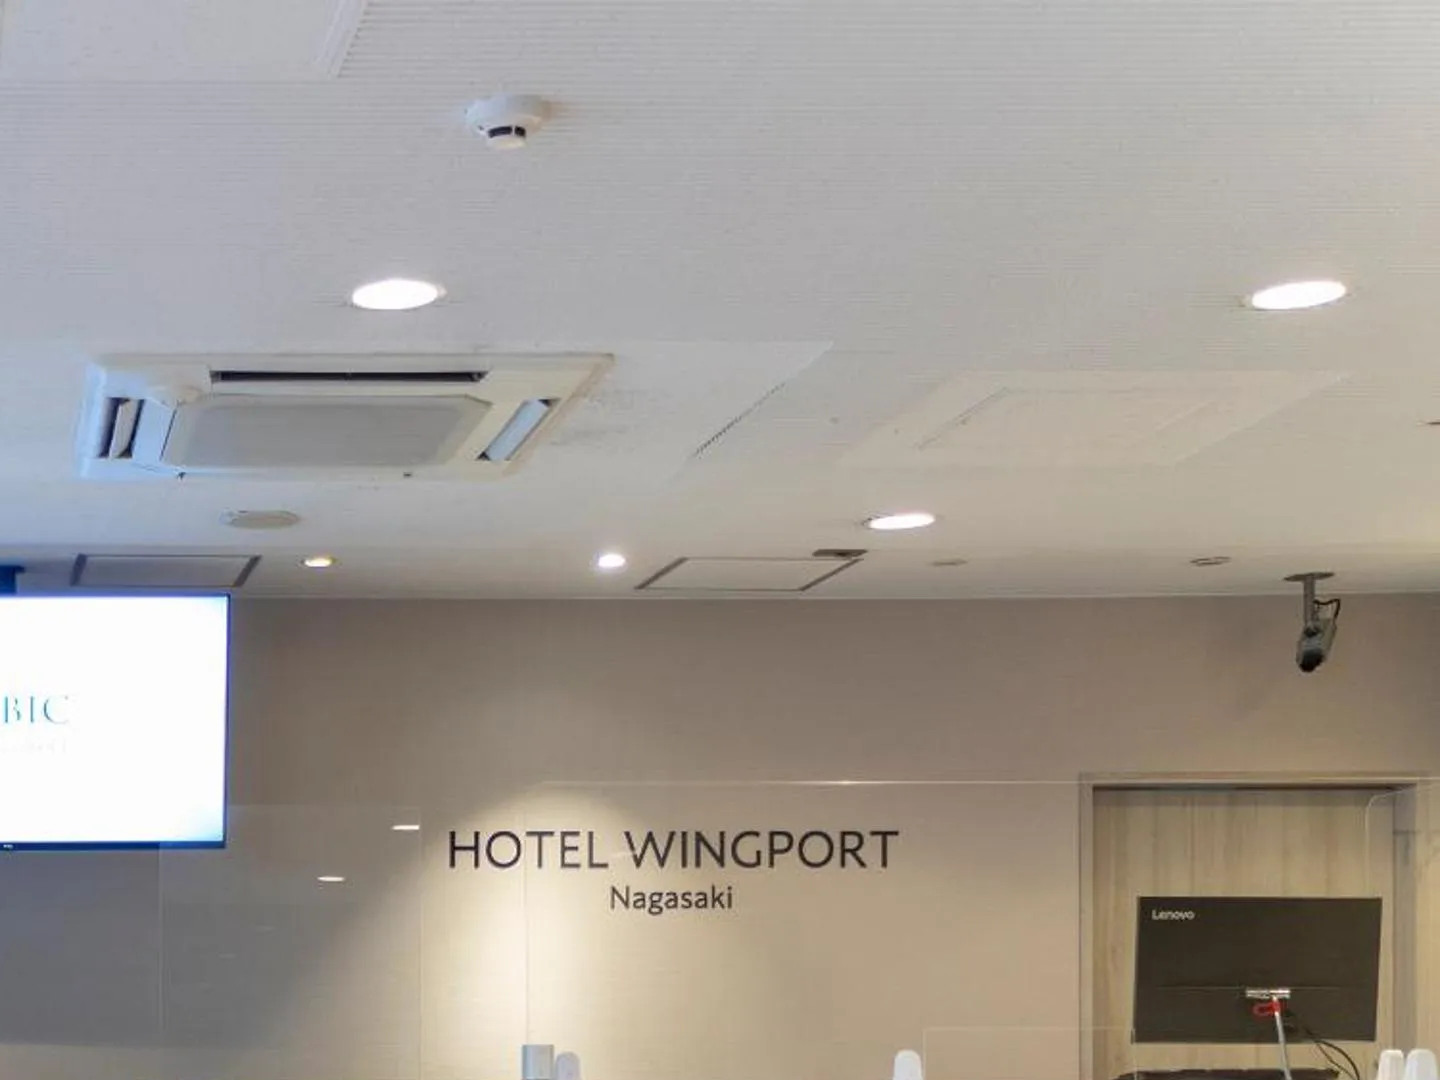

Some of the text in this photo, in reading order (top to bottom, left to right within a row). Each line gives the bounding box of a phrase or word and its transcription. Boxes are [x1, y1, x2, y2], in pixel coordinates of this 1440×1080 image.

[449, 830, 900, 869] HOTEL WINGPORT
[610, 884, 733, 916] Nagasaki
[1151, 909, 1196, 921] Lenovo
